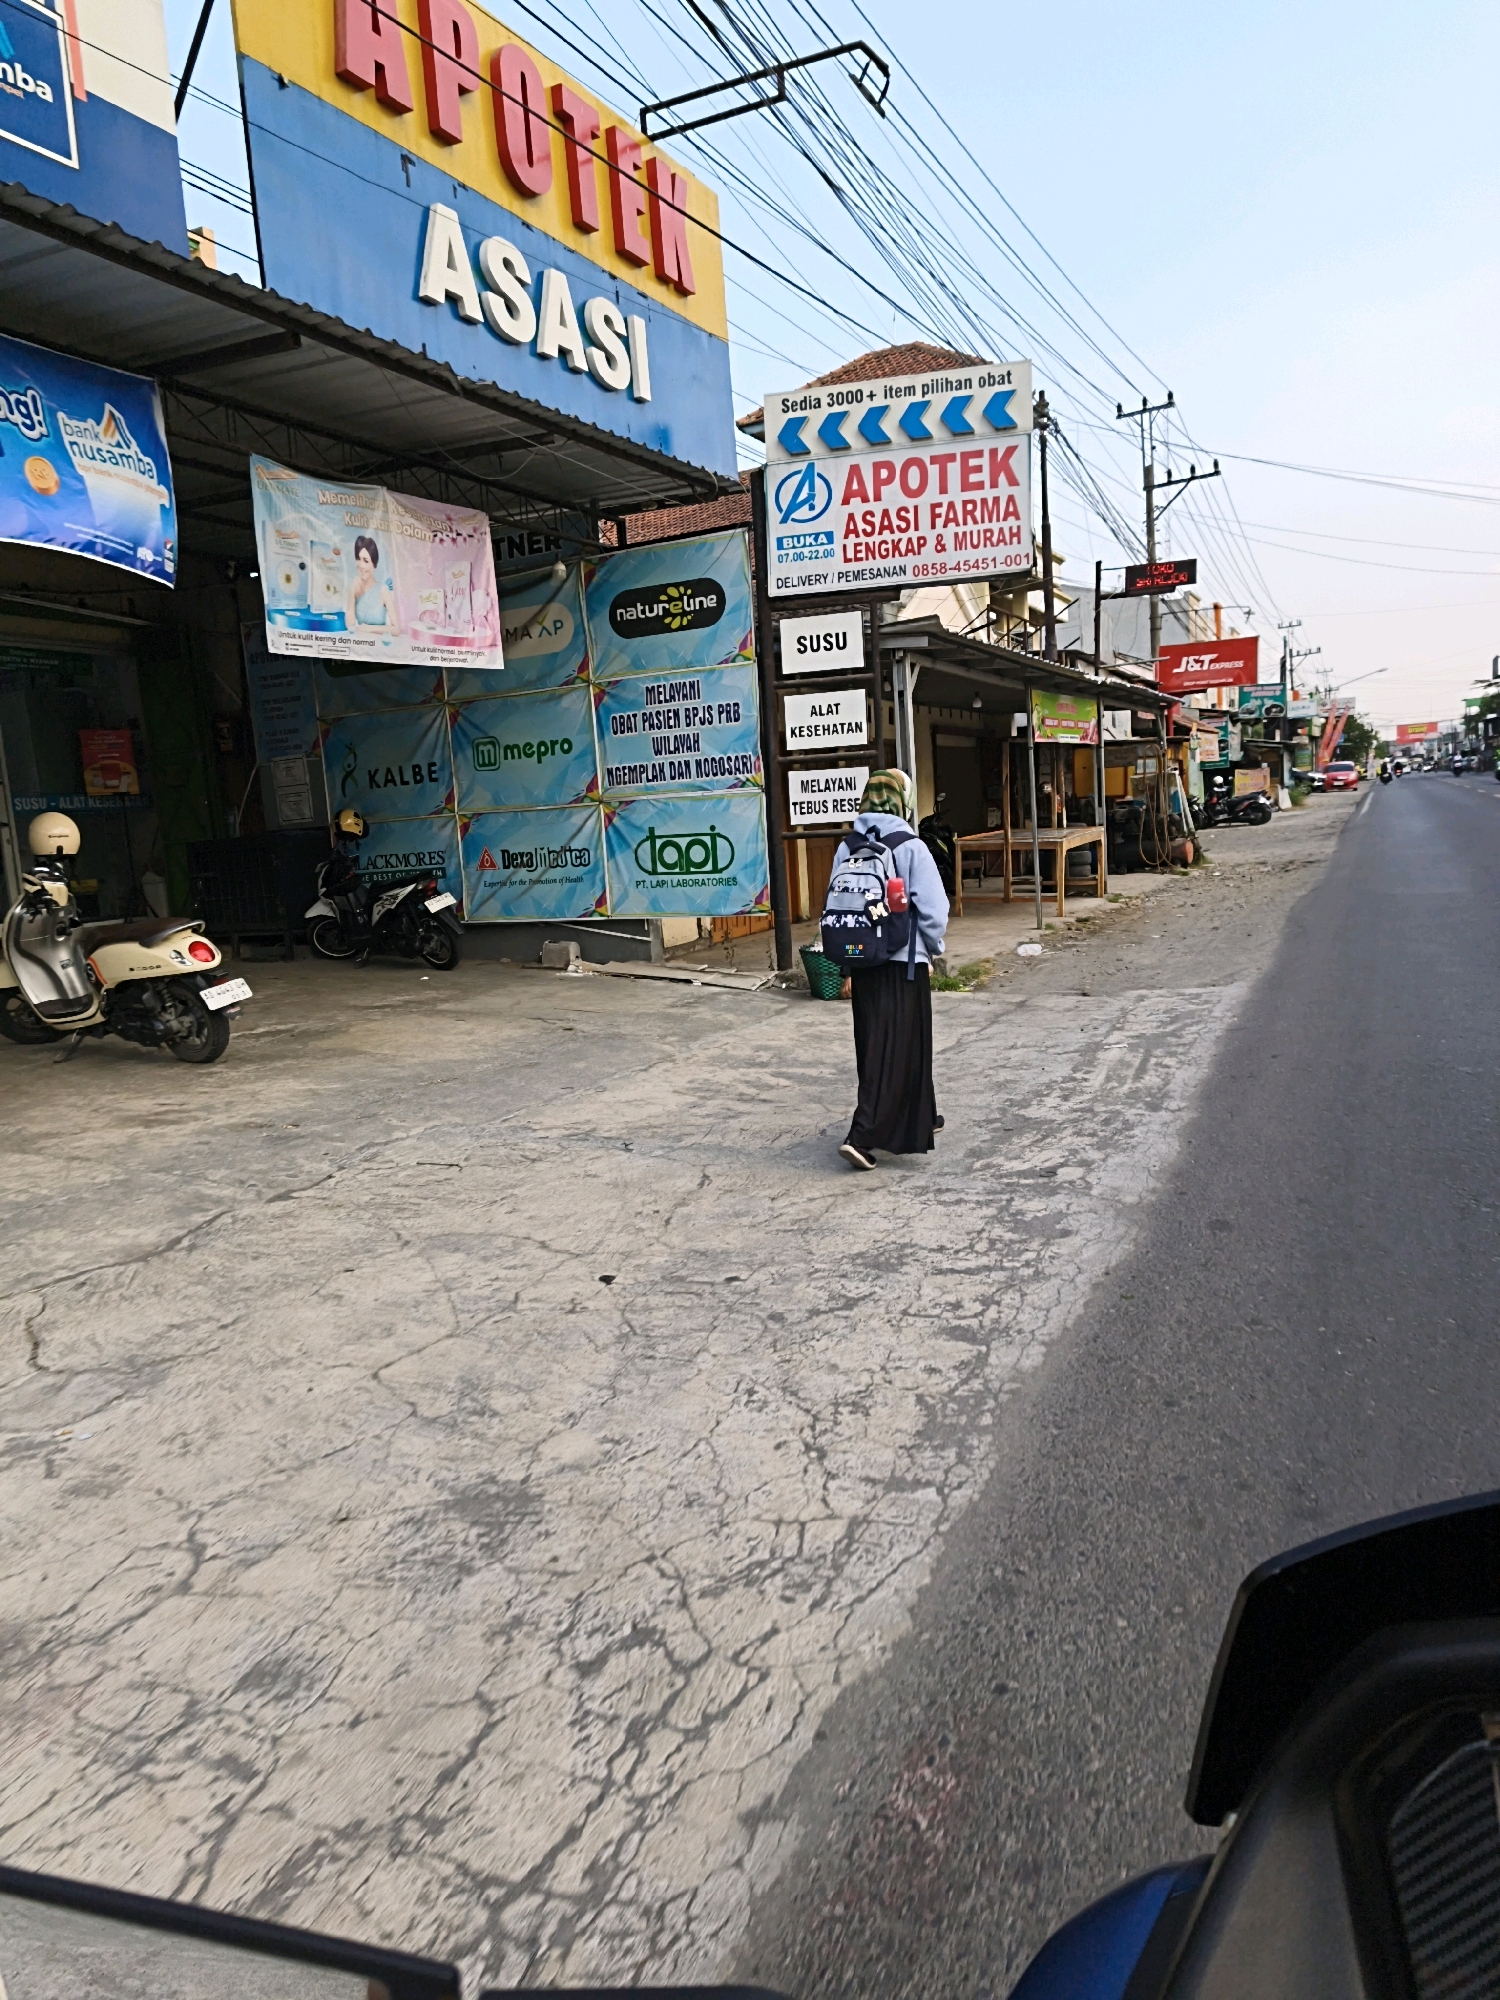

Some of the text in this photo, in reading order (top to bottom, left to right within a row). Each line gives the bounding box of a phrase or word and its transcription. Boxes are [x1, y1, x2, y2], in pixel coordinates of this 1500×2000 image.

[335, 0, 696, 296] APOTEK
[419, 203, 651, 402] ASASI
[781, 394, 822, 414] Sedia
[884, 383, 916, 400] item
[921, 377, 973, 398] pilihan
[978, 370, 1012, 388] obat
[62, 416, 102, 444] bank
[68, 440, 155, 479] nusamba
[840, 445, 1020, 506] APOTEK
[317, 489, 388, 513] Memelihara
[389, 499, 452, 532] Kesehatan
[843, 494, 1021, 539] ASASI FARMA
[343, 511, 434, 543] Kulit dari Dalam
[782, 533, 829, 548] BUKA
[843, 525, 1022, 563] LENGKAP & MURAH
[777, 548, 835, 563] 07.00-22.00
[776, 573, 829, 589] DELIVERY
[837, 564, 907, 583] PEMESANAN
[912, 552, 1031, 578] 0858-45451-001
[616, 593, 717, 622] natureline
[278, 630, 375, 647] Untuk kulit kering dan normal
[796, 631, 848, 655] SUSU
[1172, 653, 1244, 673] J&T EXPRESS
[645, 680, 700, 706] MELAYANI
[611, 702, 741, 736] OBAT PASIEN BPJS PRB
[810, 702, 841, 718] ALAT
[790, 721, 863, 739] KESEHATAN
[502, 737, 573, 765] mepro
[652, 732, 701, 756] WILAYAH
[367, 761, 439, 790] KALBE
[607, 753, 753, 787] NGEMPLAK DAN NOGOSARI
[800, 776, 857, 794] MELAYANI
[14, 796, 47, 811] SUSU
[59, 795, 86, 809] ALAT
[792, 797, 861, 816] TEBUS RESE
[355, 850, 446, 871] LACKMORES
[373, 873, 393, 881] BEST
[508, 878, 517, 889] for
[518, 878, 527, 886] the
[565, 875, 585, 883] Health
[635, 876, 738, 889] PT. LAPI LABORATORIES
[868, 902, 889, 921] M
